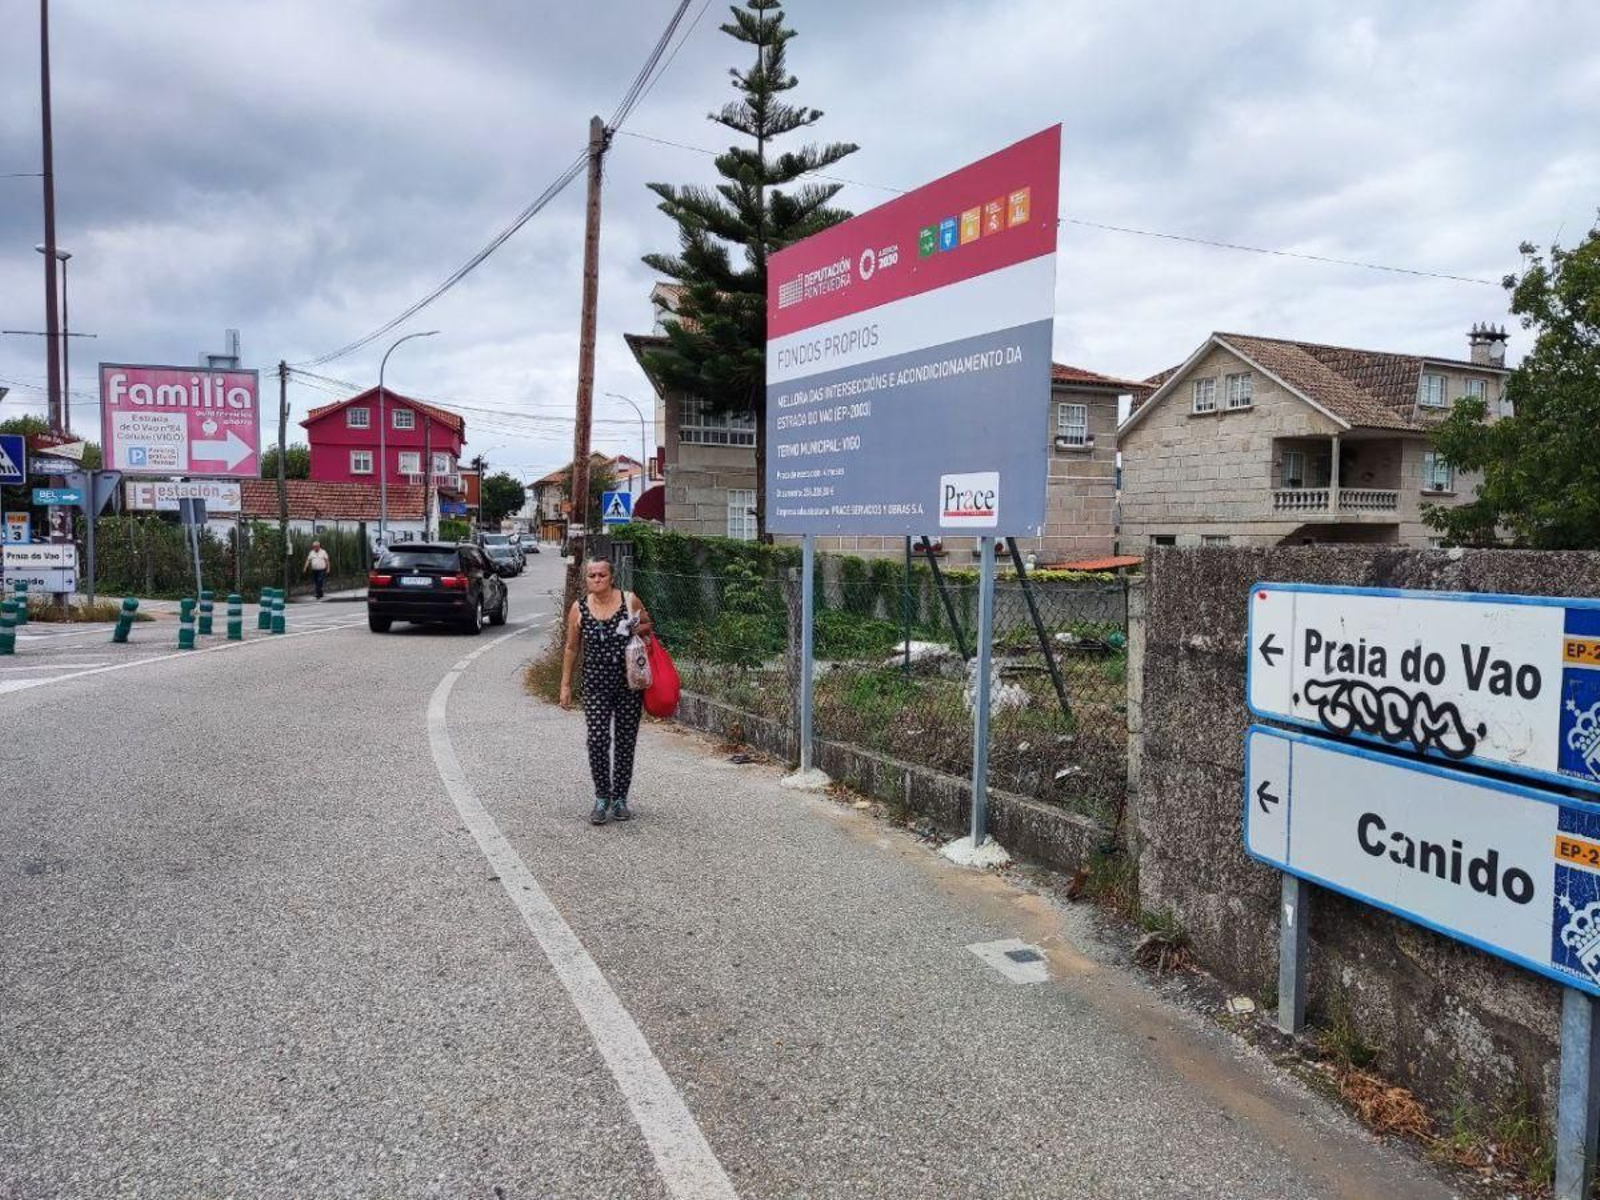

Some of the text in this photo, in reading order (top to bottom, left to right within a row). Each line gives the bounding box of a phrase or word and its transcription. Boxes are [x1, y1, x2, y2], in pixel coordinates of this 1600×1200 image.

[804, 256, 851, 287] DEPUTACIÓN
[778, 324, 878, 369] FONDOS PROPIOS
[888, 372, 896, 388] E
[897, 350, 1003, 386] ACONDICIONAMENTO
[1006, 345, 1022, 364] DA
[109, 373, 252, 409] familia
[142, 424, 160, 432] Vao
[778, 443, 799, 459] TERMO
[944, 484, 994, 511] Prace
[13, 531, 22, 540] 3
[1304, 628, 1542, 700] Praia do Vao
[1357, 812, 1535, 905] Canido
[1560, 841, 1600, 865] EP-2
